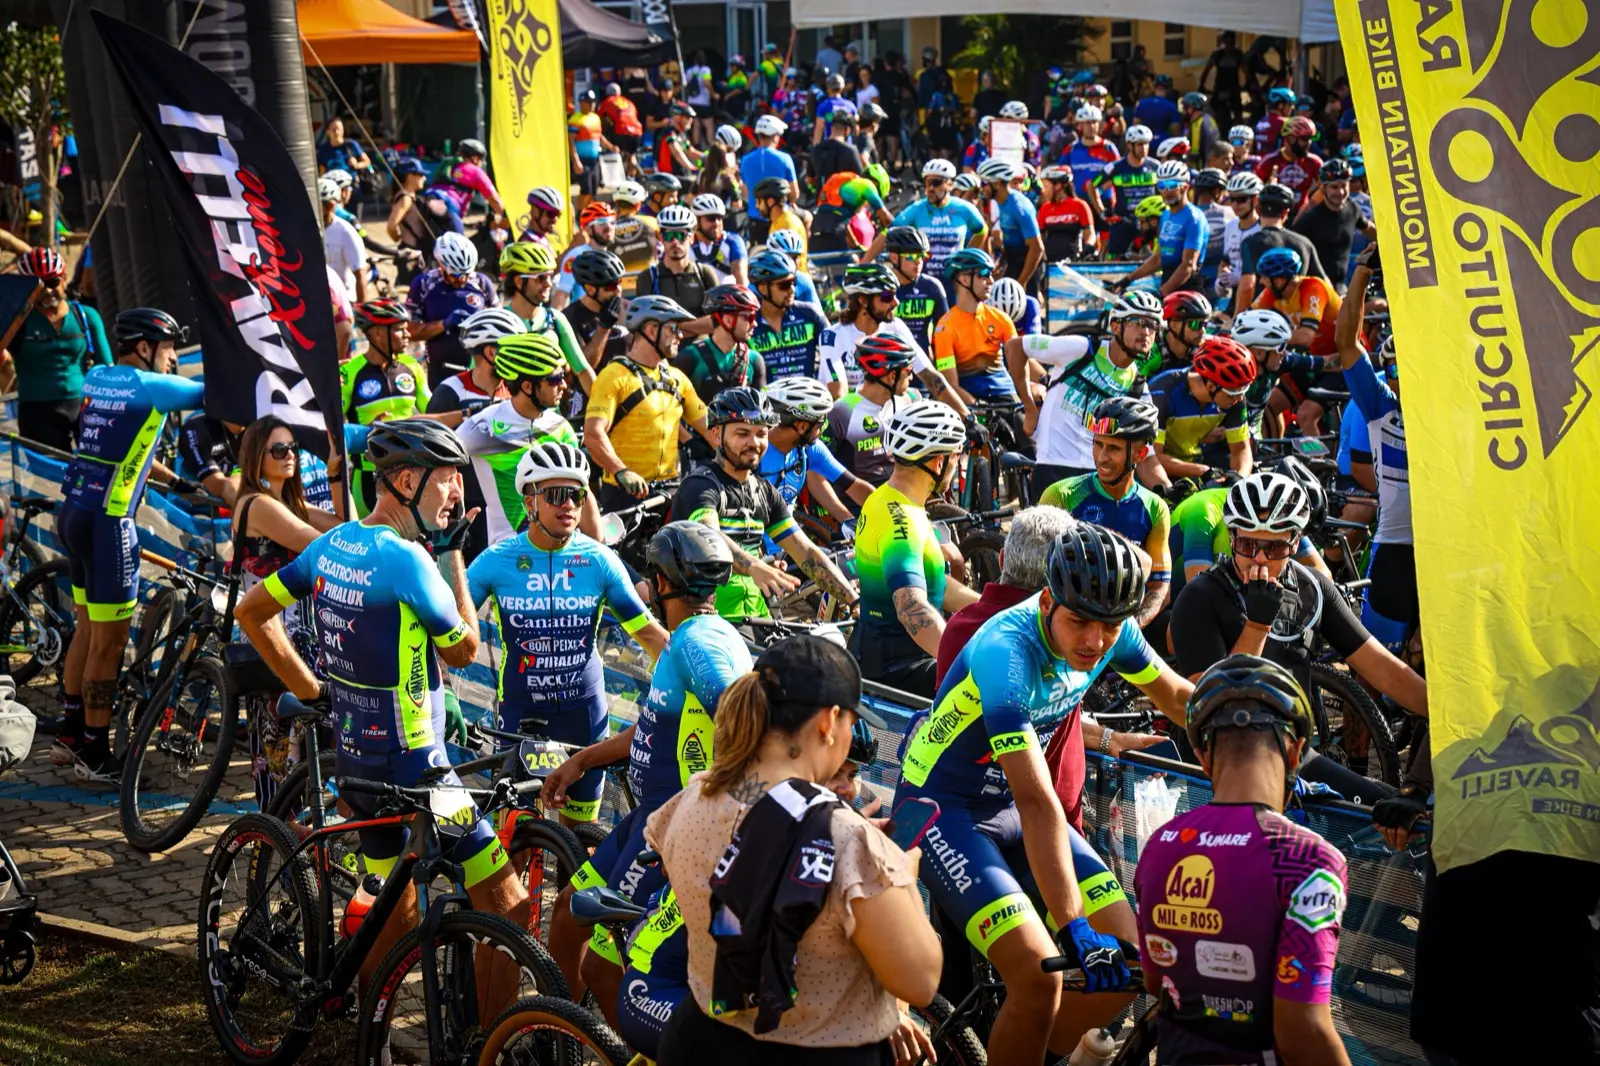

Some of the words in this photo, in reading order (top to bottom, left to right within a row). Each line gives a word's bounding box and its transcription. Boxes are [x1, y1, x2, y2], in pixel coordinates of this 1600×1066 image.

[158, 103, 328, 431] RAVELLI
[83, 427, 100, 440] avt
[120, 517, 135, 588] Canatiba
[329, 531, 370, 556] Canatiba
[317, 555, 373, 587] ERSATRONIC
[526, 569, 572, 591] avt
[323, 580, 365, 607] PIRALUX
[498, 595, 600, 610] VERSATRONIC
[509, 613, 592, 629] Canatiba
[324, 630, 343, 651] avt
[528, 640, 551, 652] BOM
[535, 652, 586, 669] PIRALUX
[525, 752, 564, 770] 243
[685, 740, 702, 761] BOM
[1160, 829, 1179, 843] EU
[1196, 831, 1252, 848] SUMARÉ
[1167, 865, 1213, 902] Açaí
[1157, 907, 1178, 926] MIL
[1190, 911, 1219, 930] ROSS
[373, 998, 387, 1023] NO
